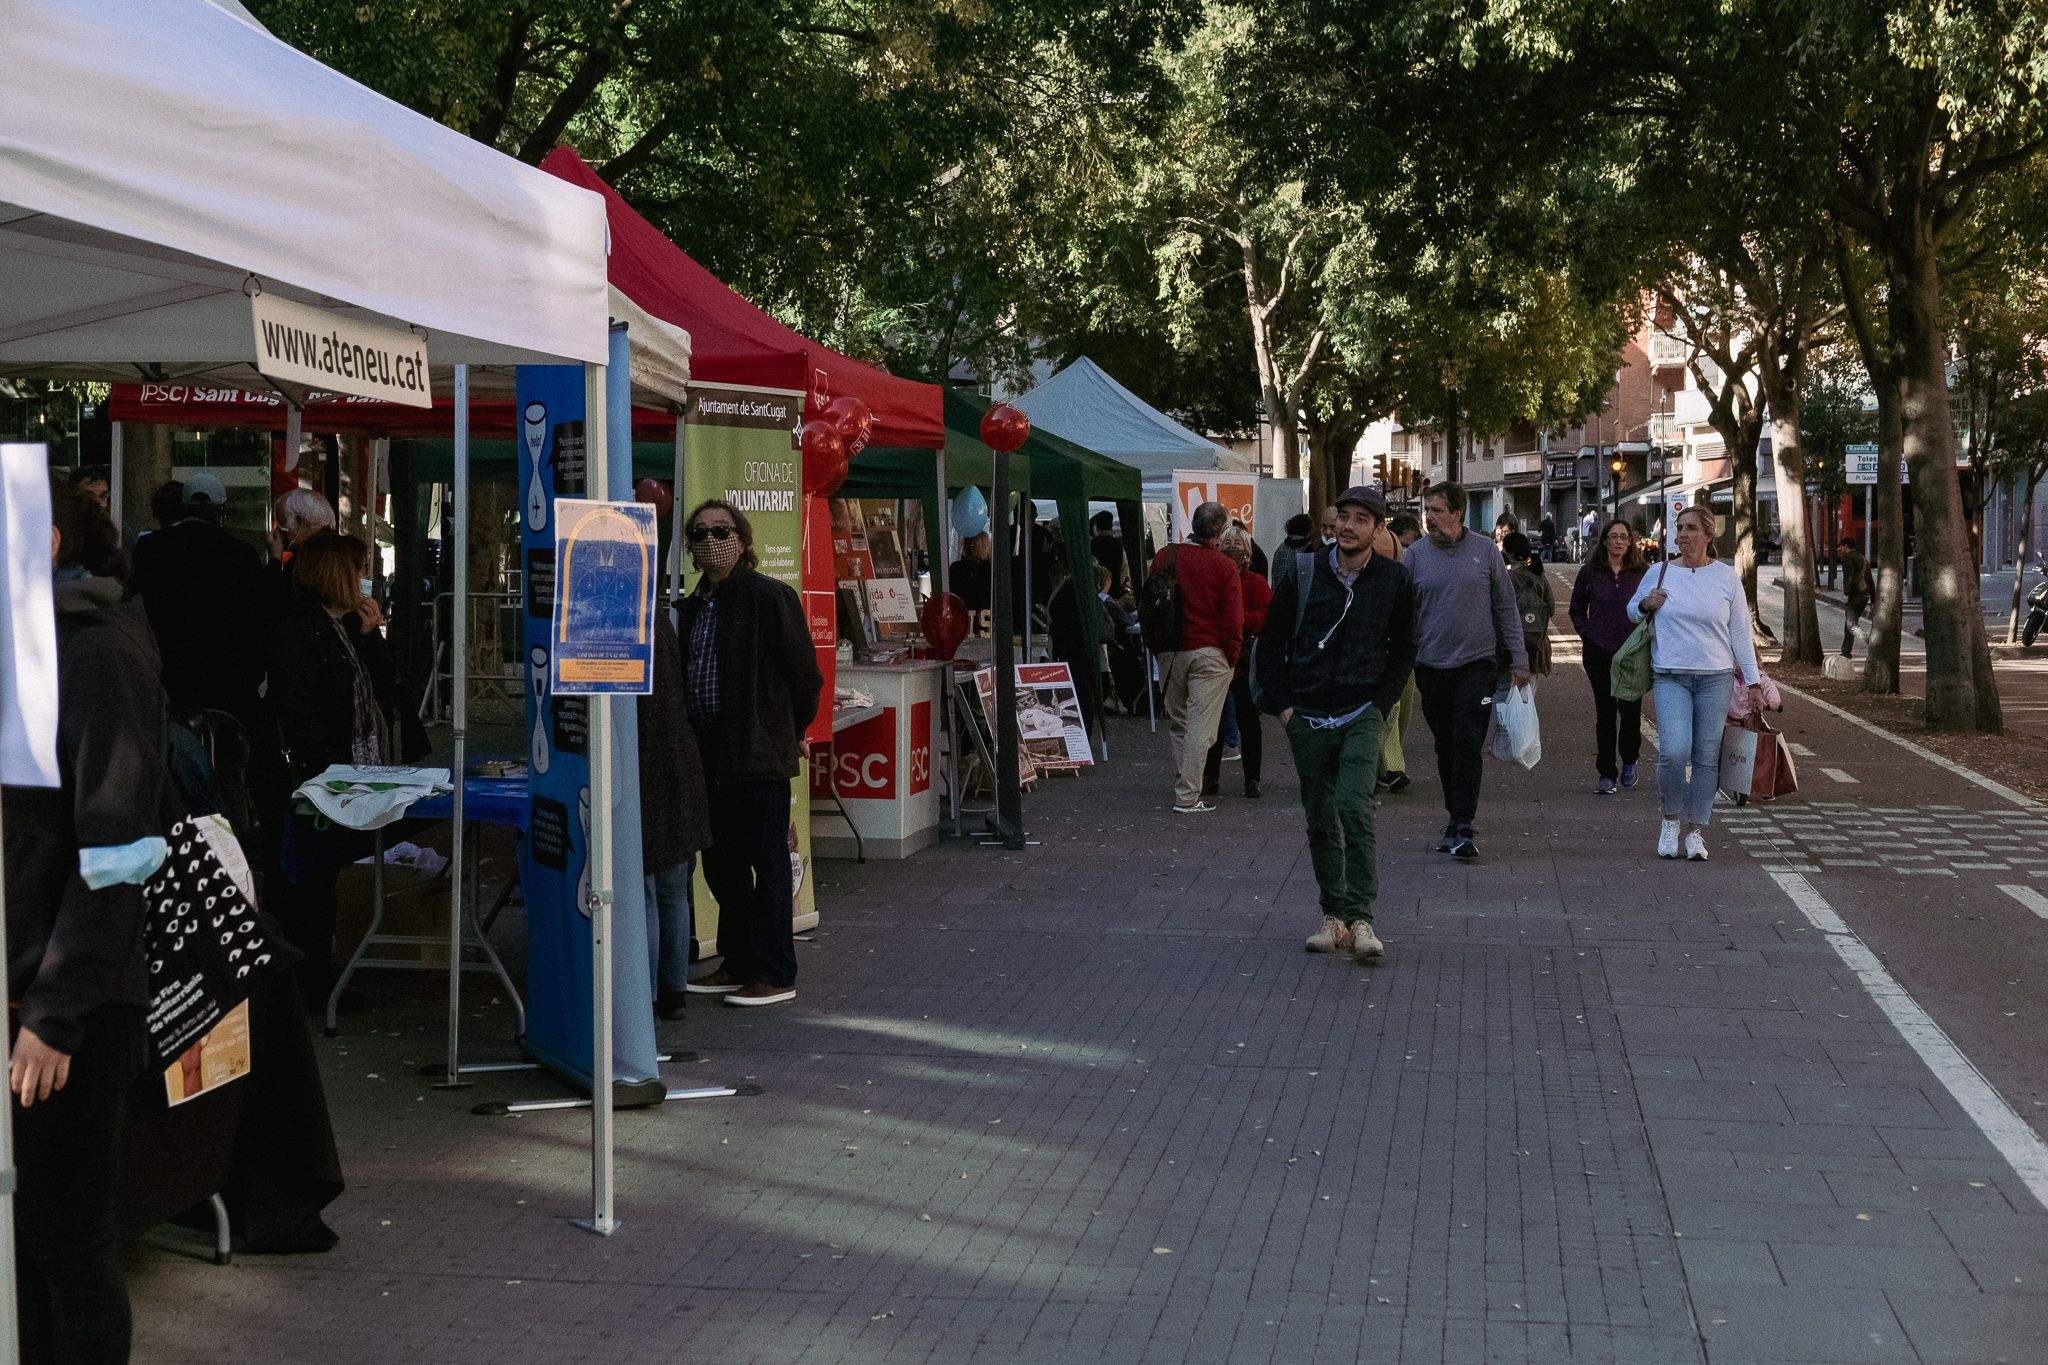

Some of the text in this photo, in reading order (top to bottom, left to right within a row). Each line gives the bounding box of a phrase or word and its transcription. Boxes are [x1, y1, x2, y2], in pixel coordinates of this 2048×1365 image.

[261, 319, 425, 392] www.ateneu.cat
[698, 397, 739, 416] Ajuntament
[740, 400, 750, 416] de
[744, 461, 794, 483] OFICINA DE
[725, 489, 794, 512] VOLUNTARIAT
[815, 752, 889, 789] PSC
[911, 746, 929, 784] PSC
